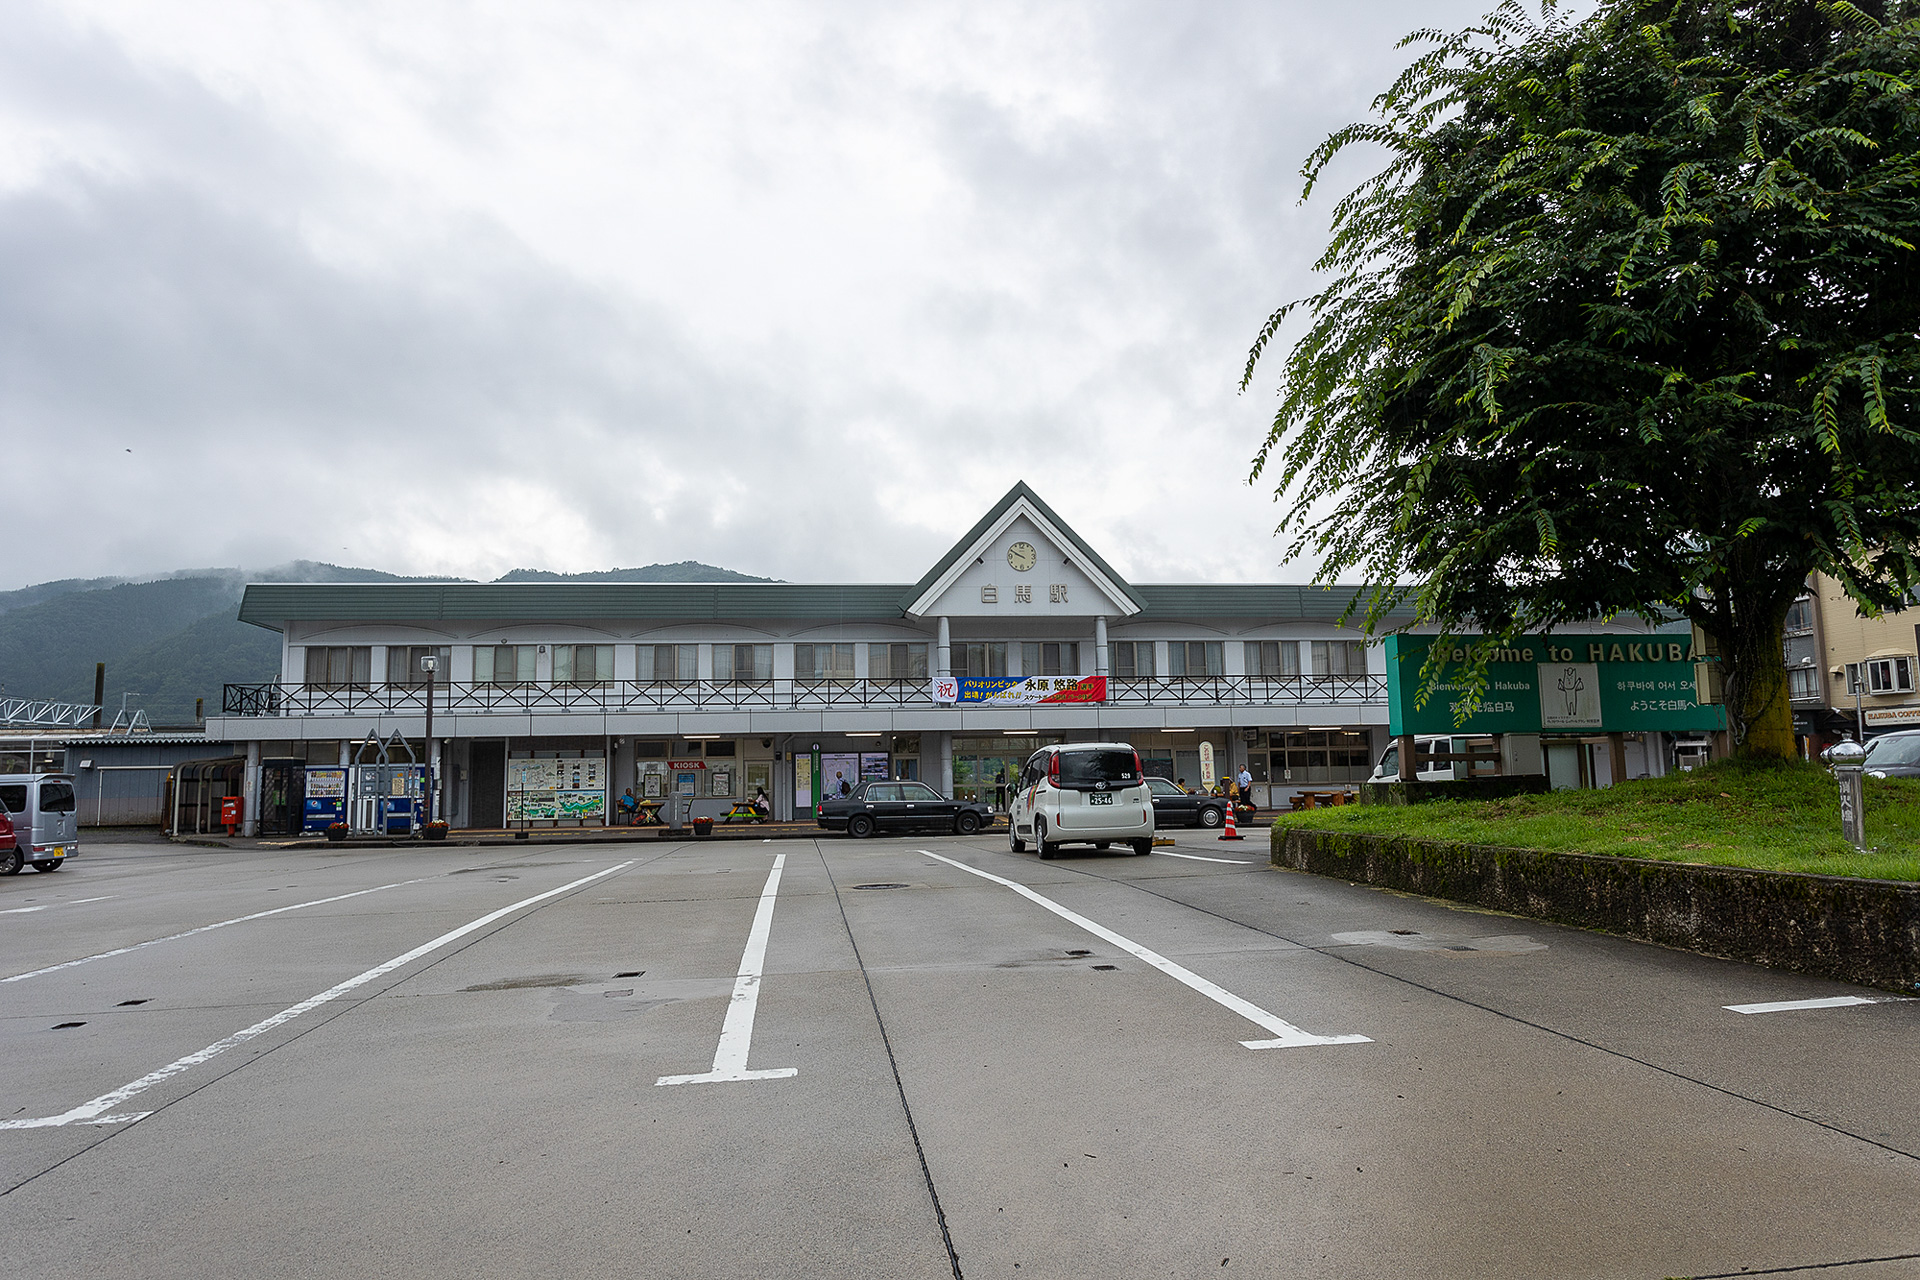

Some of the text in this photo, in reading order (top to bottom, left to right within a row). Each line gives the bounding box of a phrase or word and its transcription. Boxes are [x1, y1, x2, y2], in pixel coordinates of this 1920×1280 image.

[981, 584, 1068, 603] 白馬駅
[1549, 645, 1573, 661] to
[1589, 643, 1701, 662] HAKUBA
[937, 681, 955, 698] 祝
[964, 680, 1018, 688] パリオリンピック
[1025, 679, 1049, 691] 永原
[1054, 679, 1078, 691] 悠路
[1495, 682, 1530, 690] Hakuba
[1617, 681, 1655, 691] 하쿠바에
[1658, 681, 1676, 691] 어서
[1630, 700, 1697, 711] ようこそ白馬へ
[1867, 711, 1897, 720] HAKUBA
